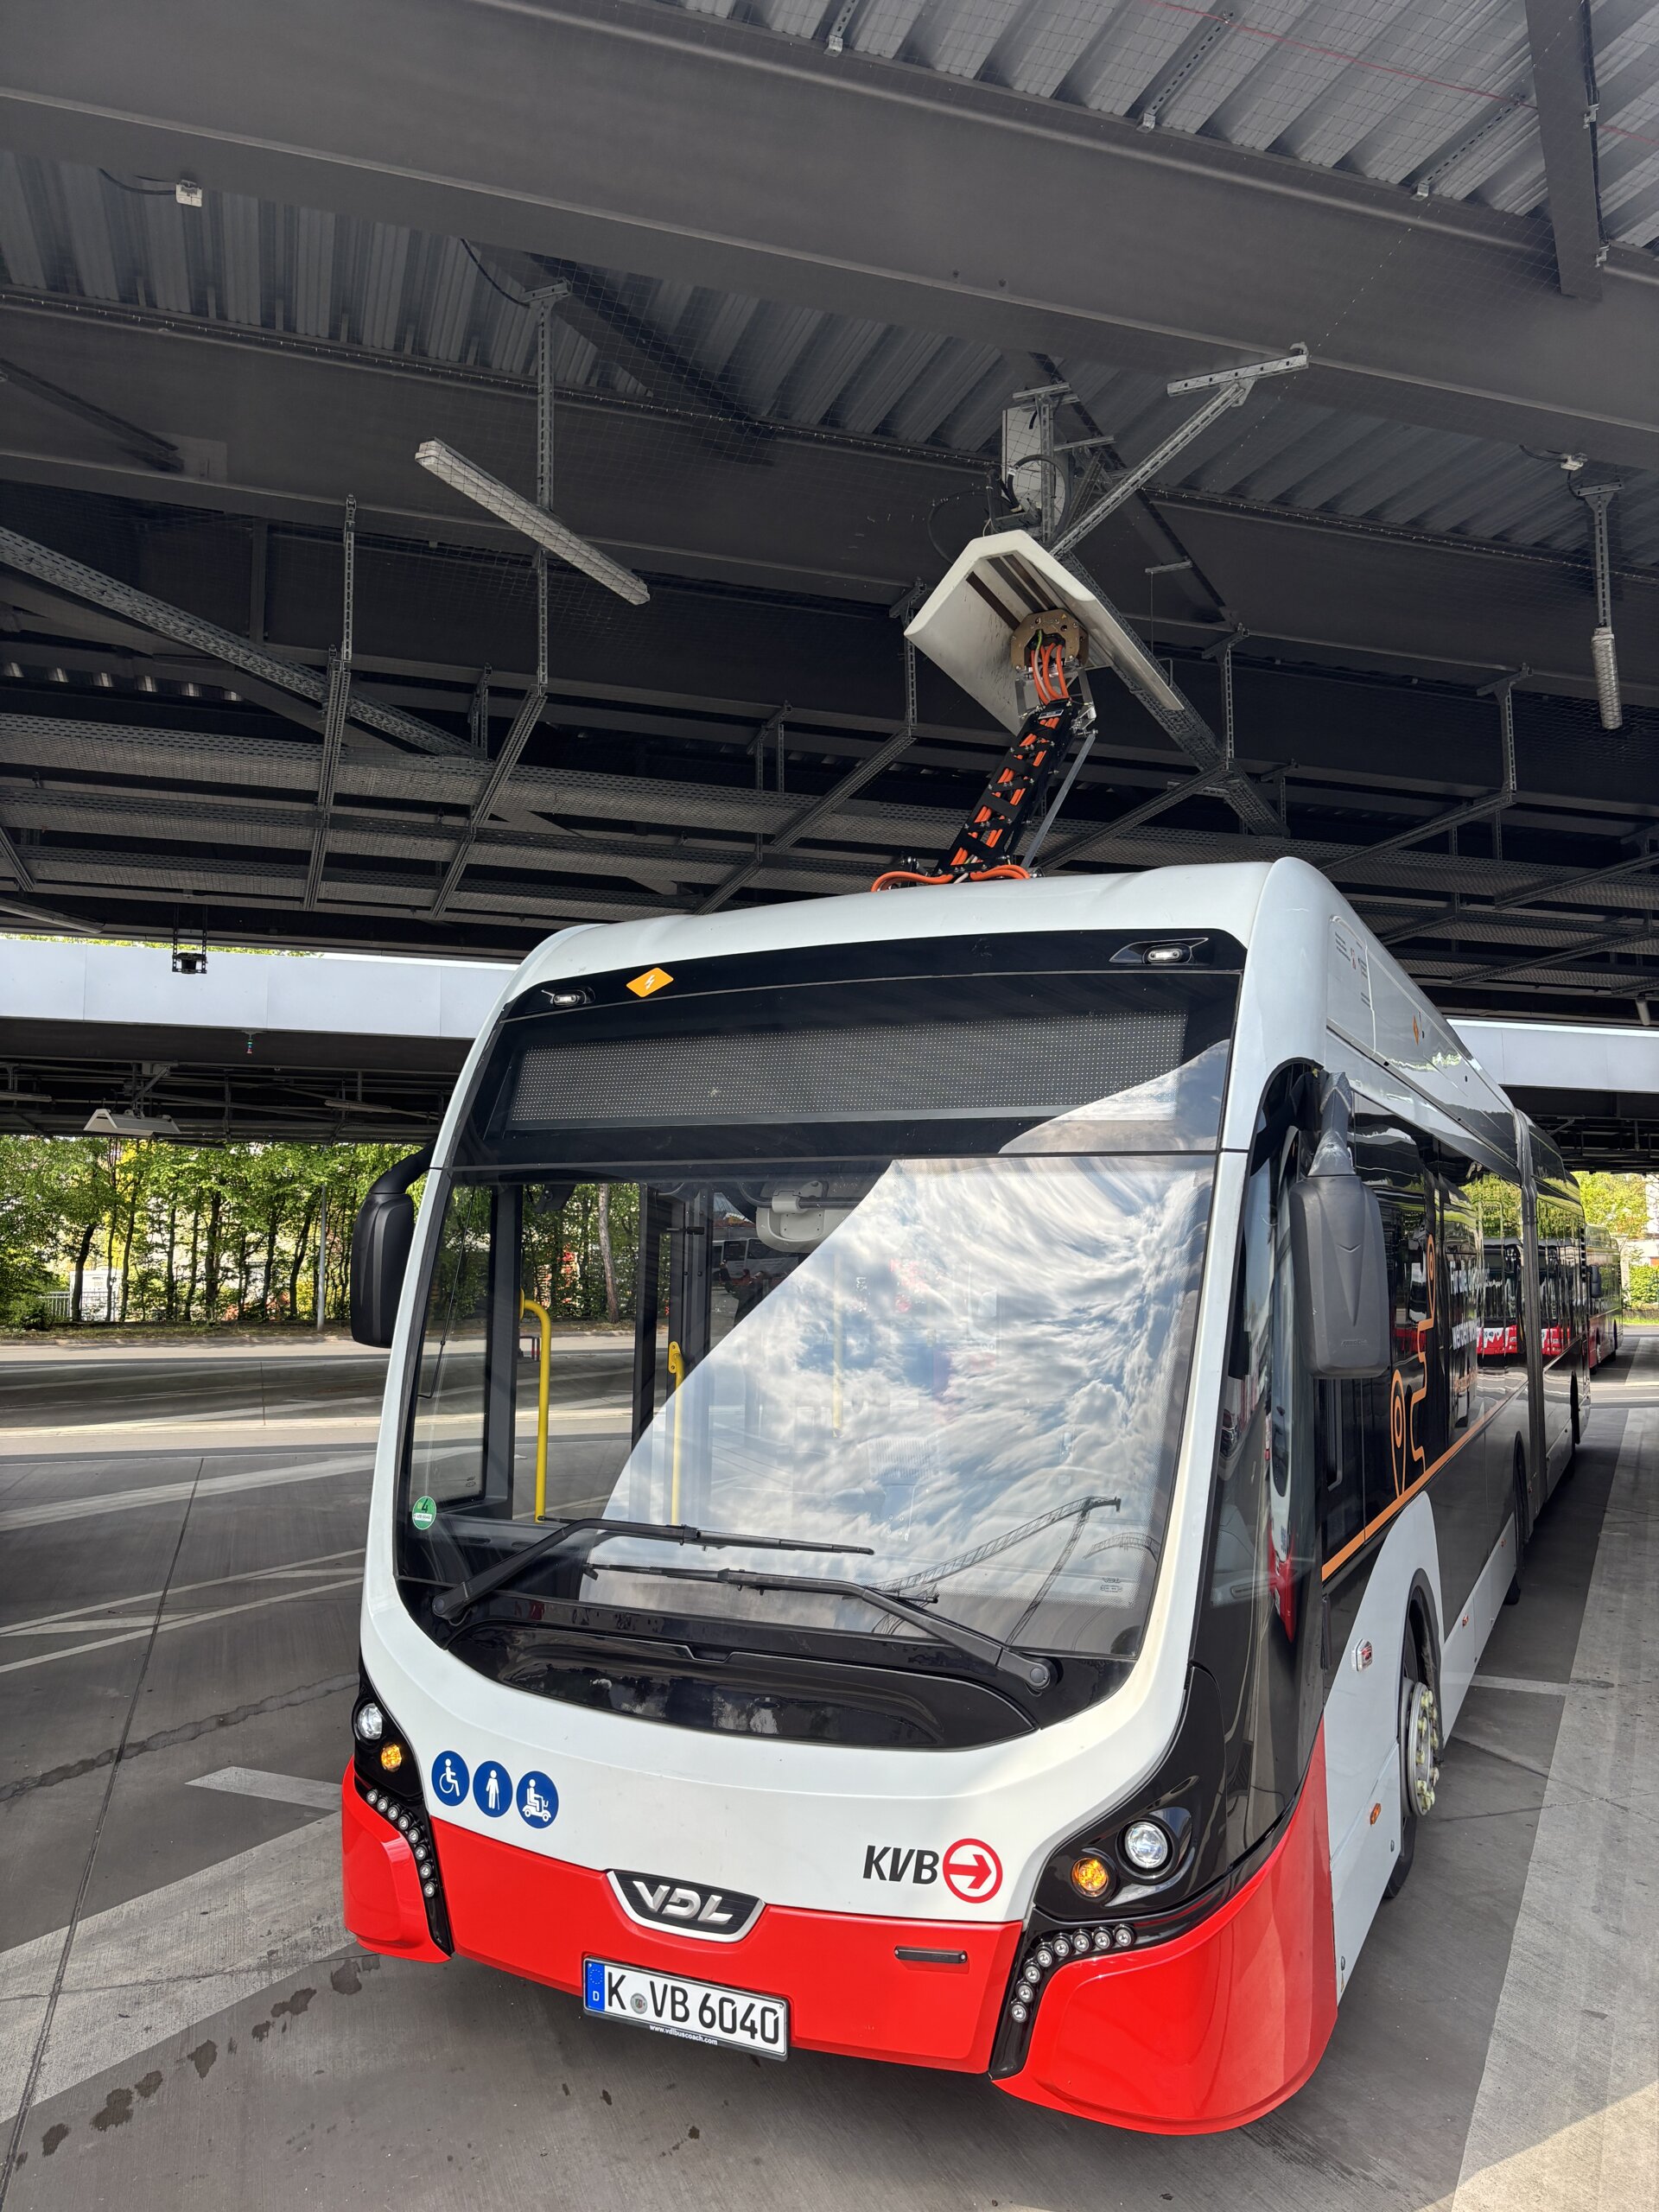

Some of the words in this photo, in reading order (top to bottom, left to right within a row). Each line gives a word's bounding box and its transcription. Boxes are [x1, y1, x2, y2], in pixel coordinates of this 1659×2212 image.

[421, 1497, 429, 1513] 4
[862, 1845, 940, 1885] KVB
[632, 1880, 734, 1925] VDL
[592, 1991, 600, 2001] D
[607, 1972, 626, 2011] K
[650, 1980, 690, 2023] VB
[698, 1993, 779, 2045] 6040
[649, 2024, 718, 2045] www.vdlbuscoach.com
